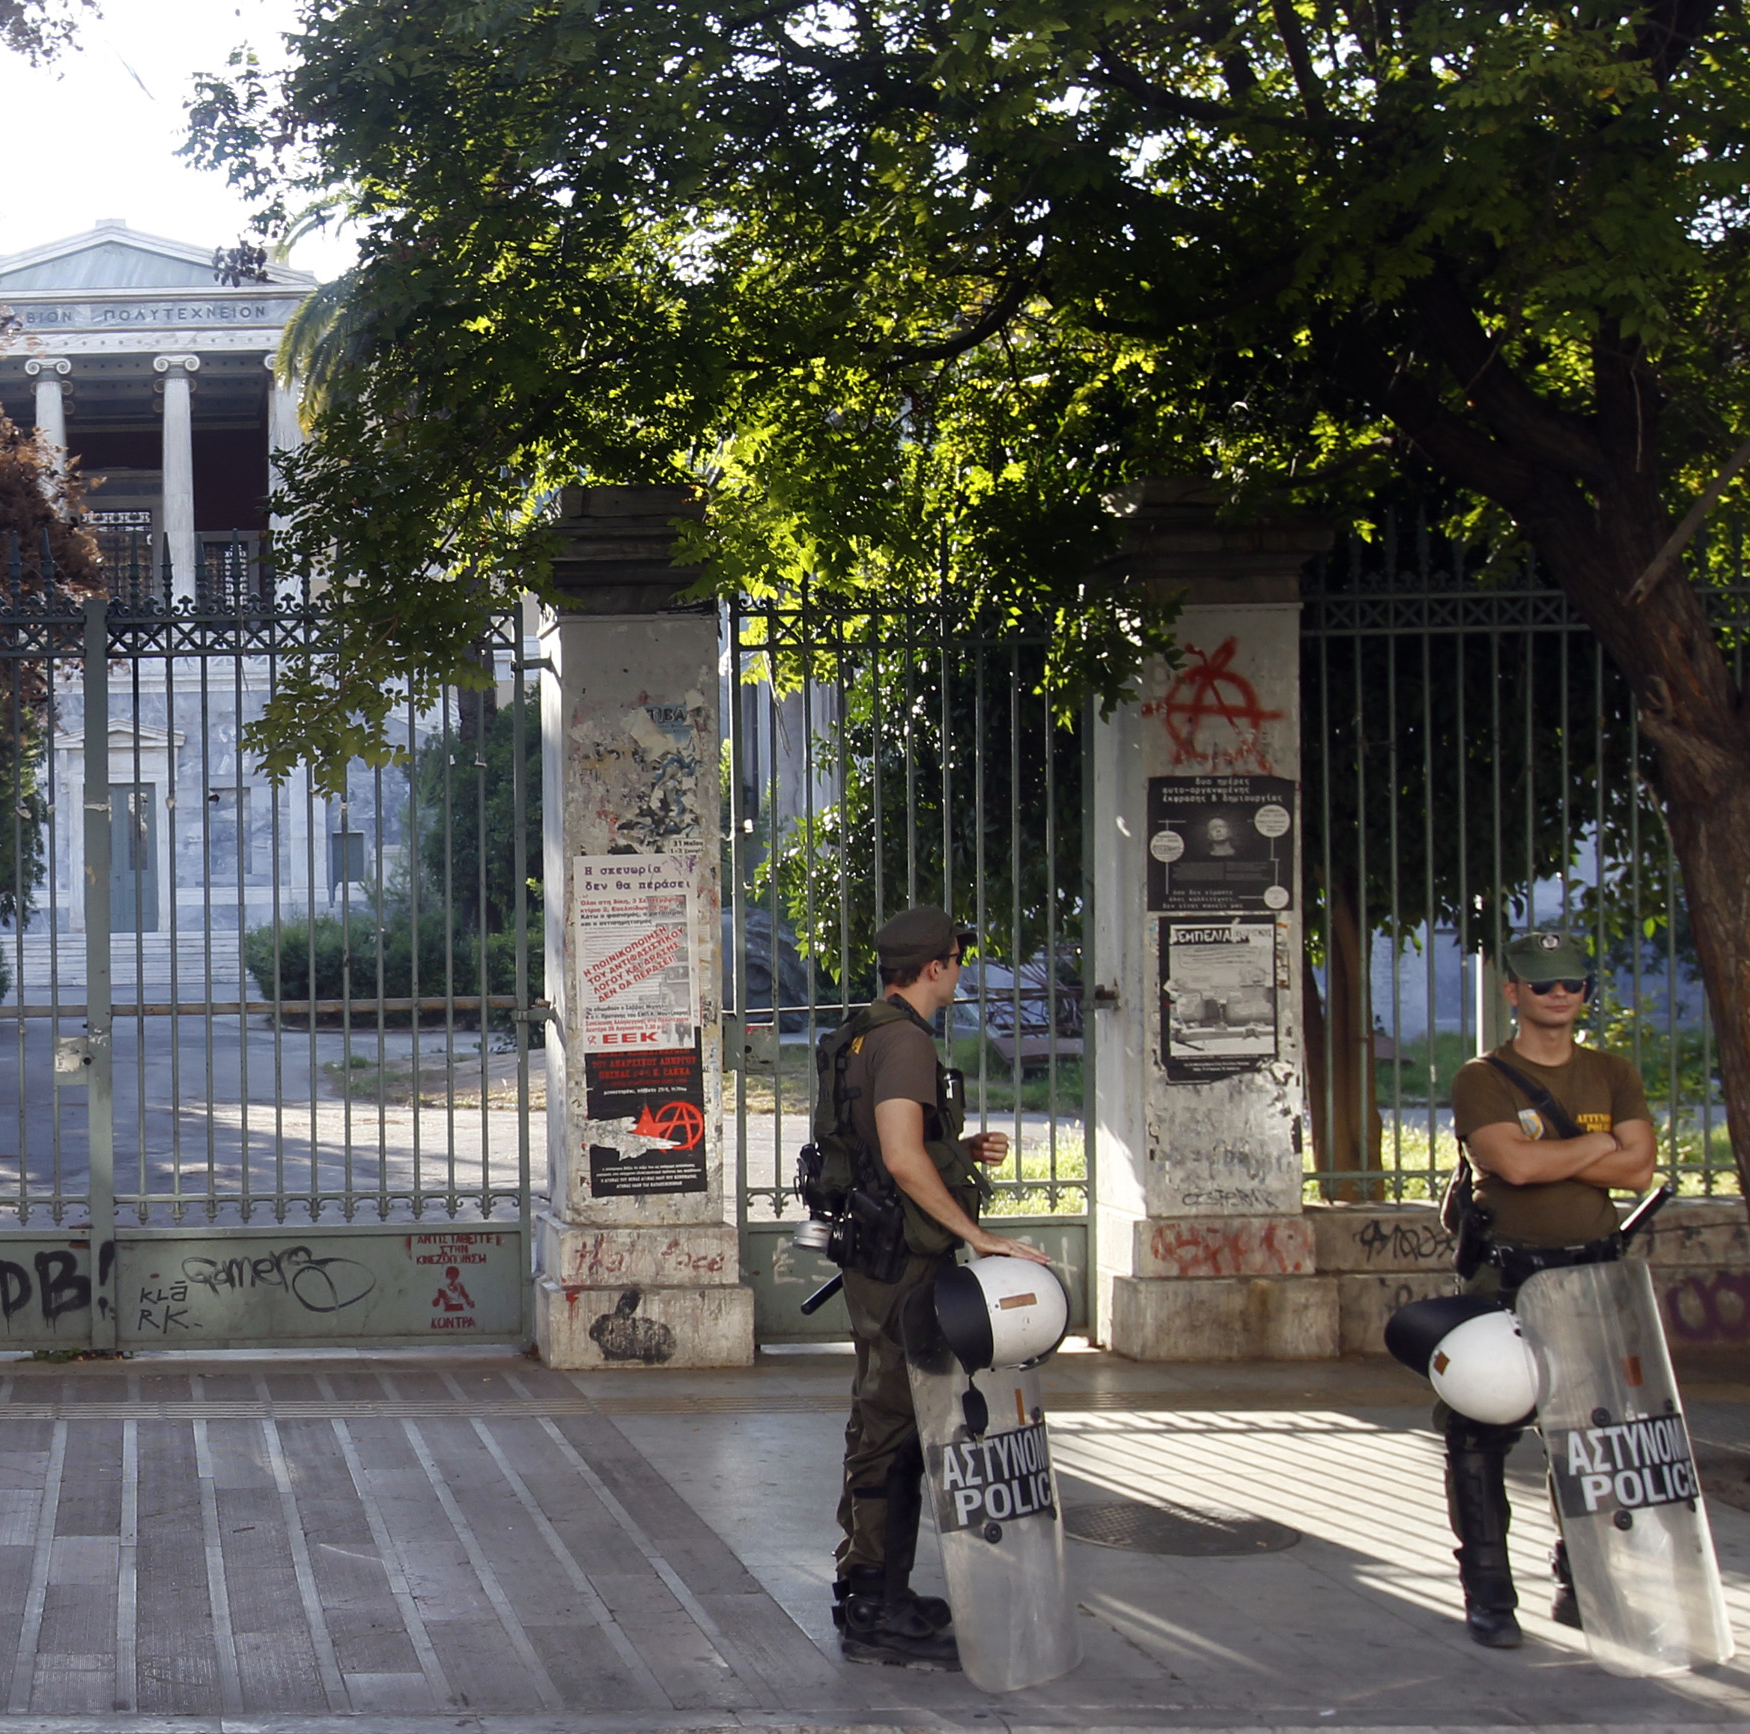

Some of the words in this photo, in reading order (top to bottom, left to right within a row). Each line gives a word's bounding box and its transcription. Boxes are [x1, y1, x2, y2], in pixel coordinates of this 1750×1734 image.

[103, 306, 266, 322] ΠΟΛΥΤΕΧΝΕΙΟΝ
[600, 866, 662, 876] σκευωρία
[585, 882, 607, 891] δεν
[616, 881, 631, 890] θα
[639, 880, 690, 891] περάσει
[1171, 928, 1232, 943] ΕΜΠΕΛΙΑ
[583, 968, 592, 977] Η
[592, 925, 668, 972] ΠΟΙΝΙΚΟΠΟΙΗΣΗ
[587, 970, 606, 985] ΤΟΥ
[609, 927, 685, 974] ΑΝΤΙΦΑΣΙΣΤΙΚΟΥ
[593, 972, 624, 994] ΛΟΓΟΥ
[625, 962, 643, 976] ΚΑΙ
[644, 941, 681, 966] ΔΡΑΣΗΣ
[598, 988, 617, 1003] ΔΕΝ
[602, 1032, 659, 1044] ΕΕΚ
[954, 1471, 1052, 1527] POLIC
